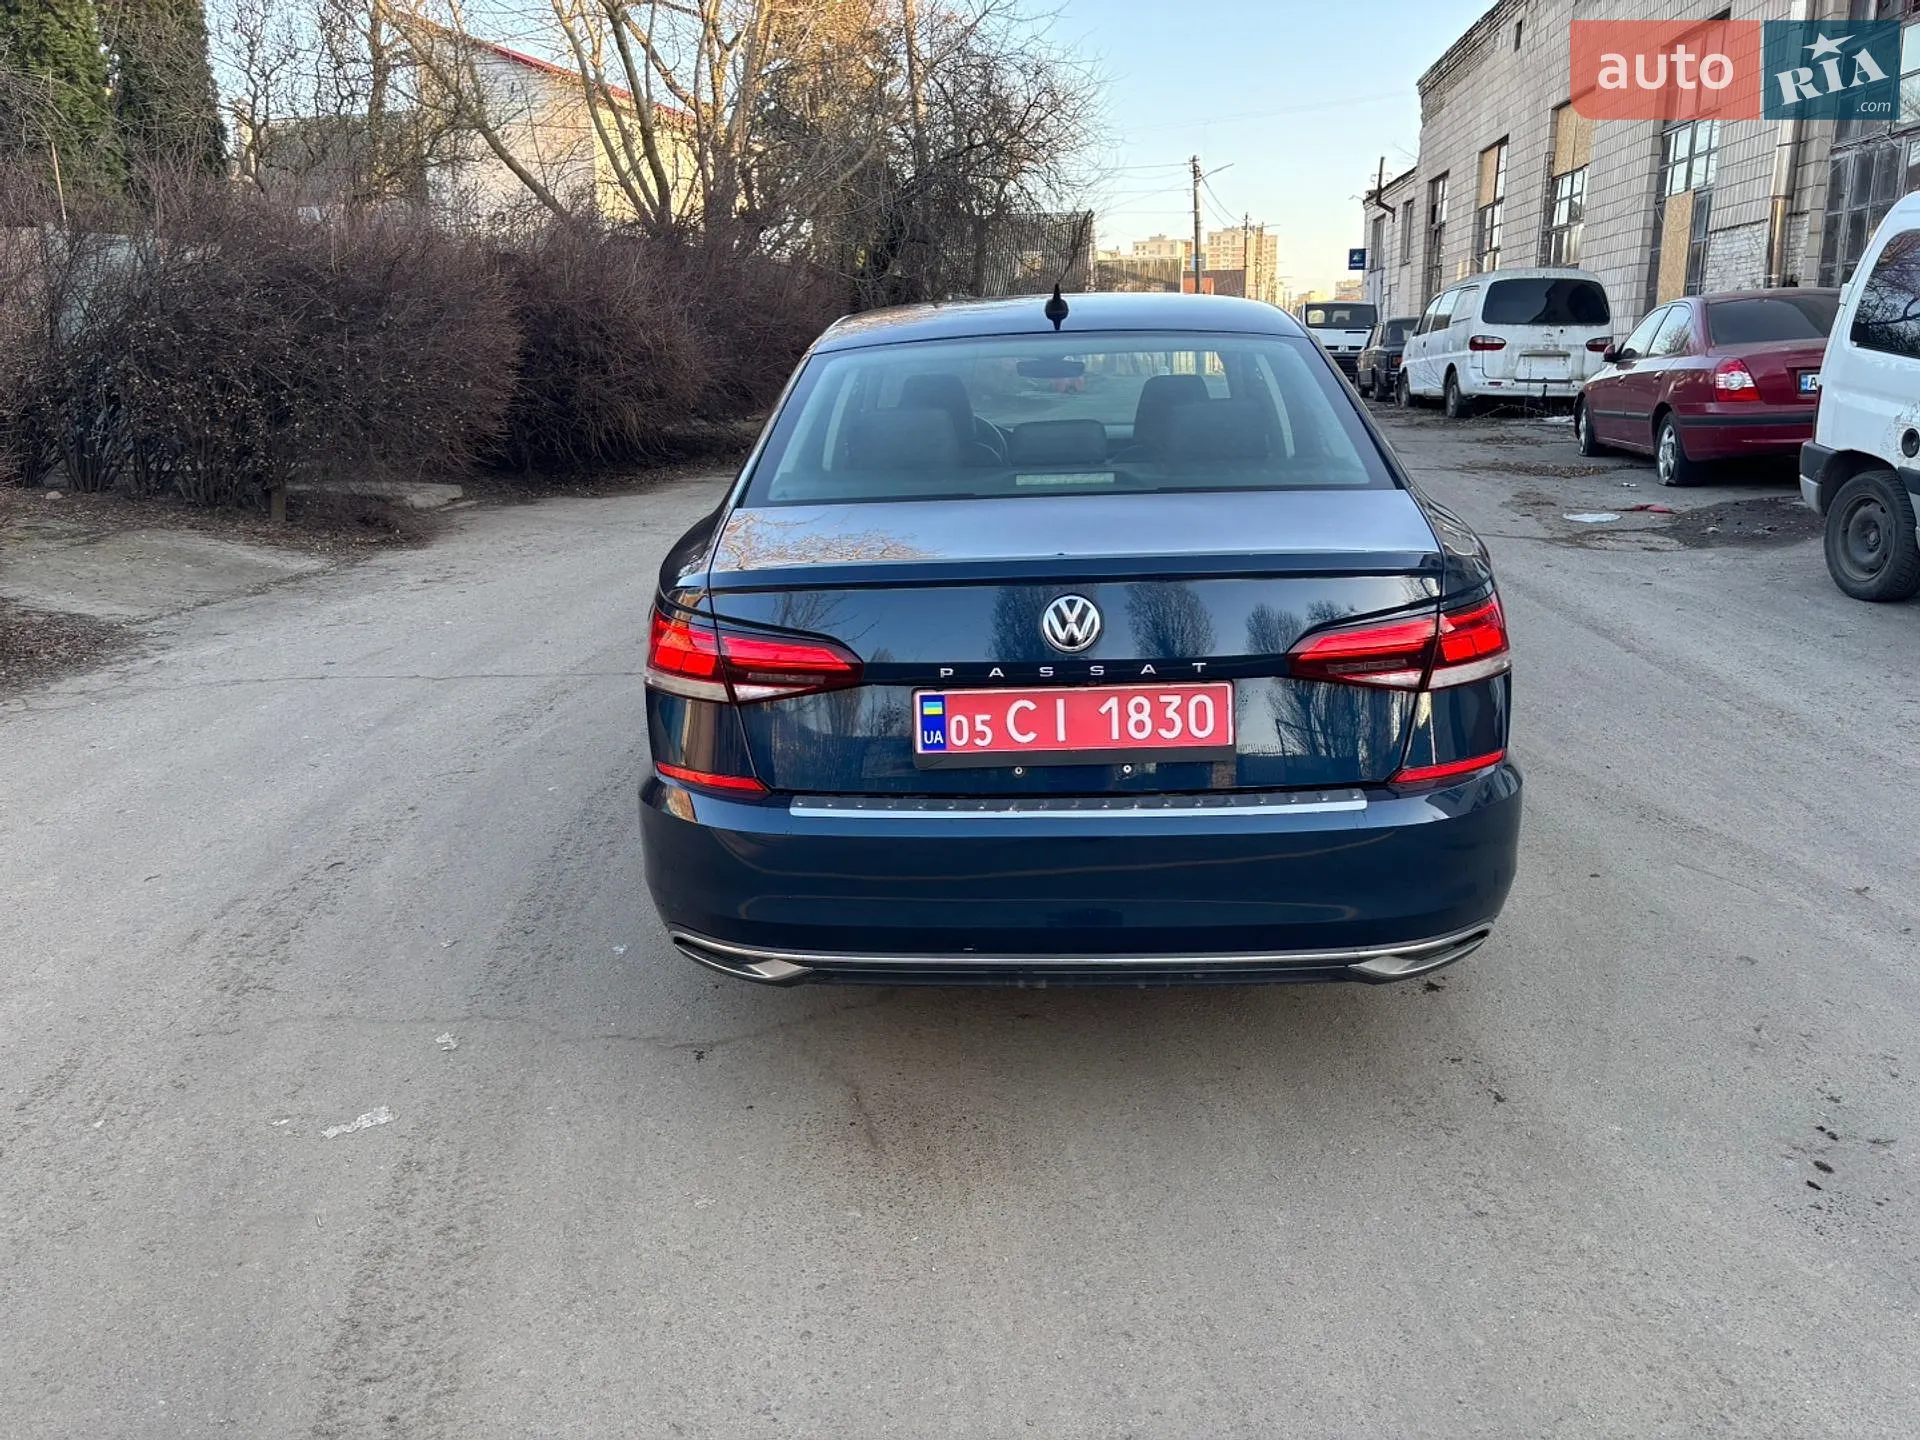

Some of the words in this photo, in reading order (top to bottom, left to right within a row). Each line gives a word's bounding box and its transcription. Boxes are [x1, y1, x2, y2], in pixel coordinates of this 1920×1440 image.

[939, 662, 1207, 679] PASSAT
[949, 713, 993, 747] 05
[1098, 693, 1215, 740] 1830
[923, 730, 944, 744] UA
